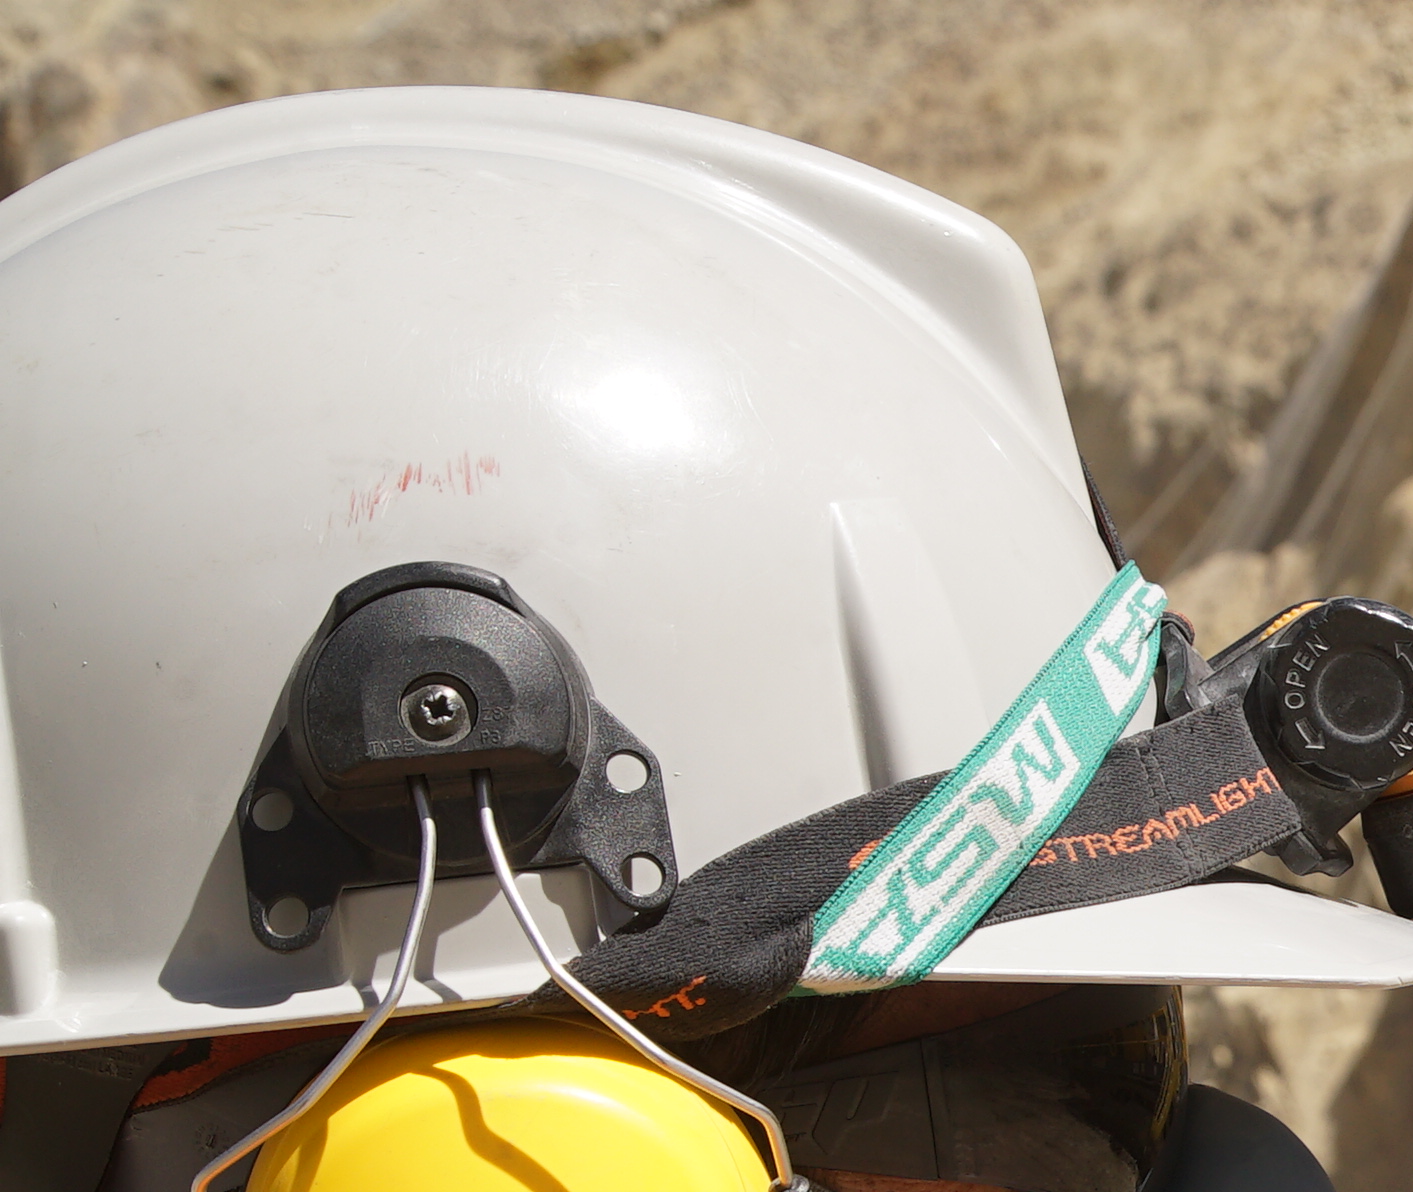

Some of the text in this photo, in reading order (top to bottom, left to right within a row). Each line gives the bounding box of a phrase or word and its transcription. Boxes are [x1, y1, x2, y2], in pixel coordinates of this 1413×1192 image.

[1284, 633, 1331, 710] OPEN
[367, 738, 416, 757] TYPE
[810, 718, 1068, 978] MSA
